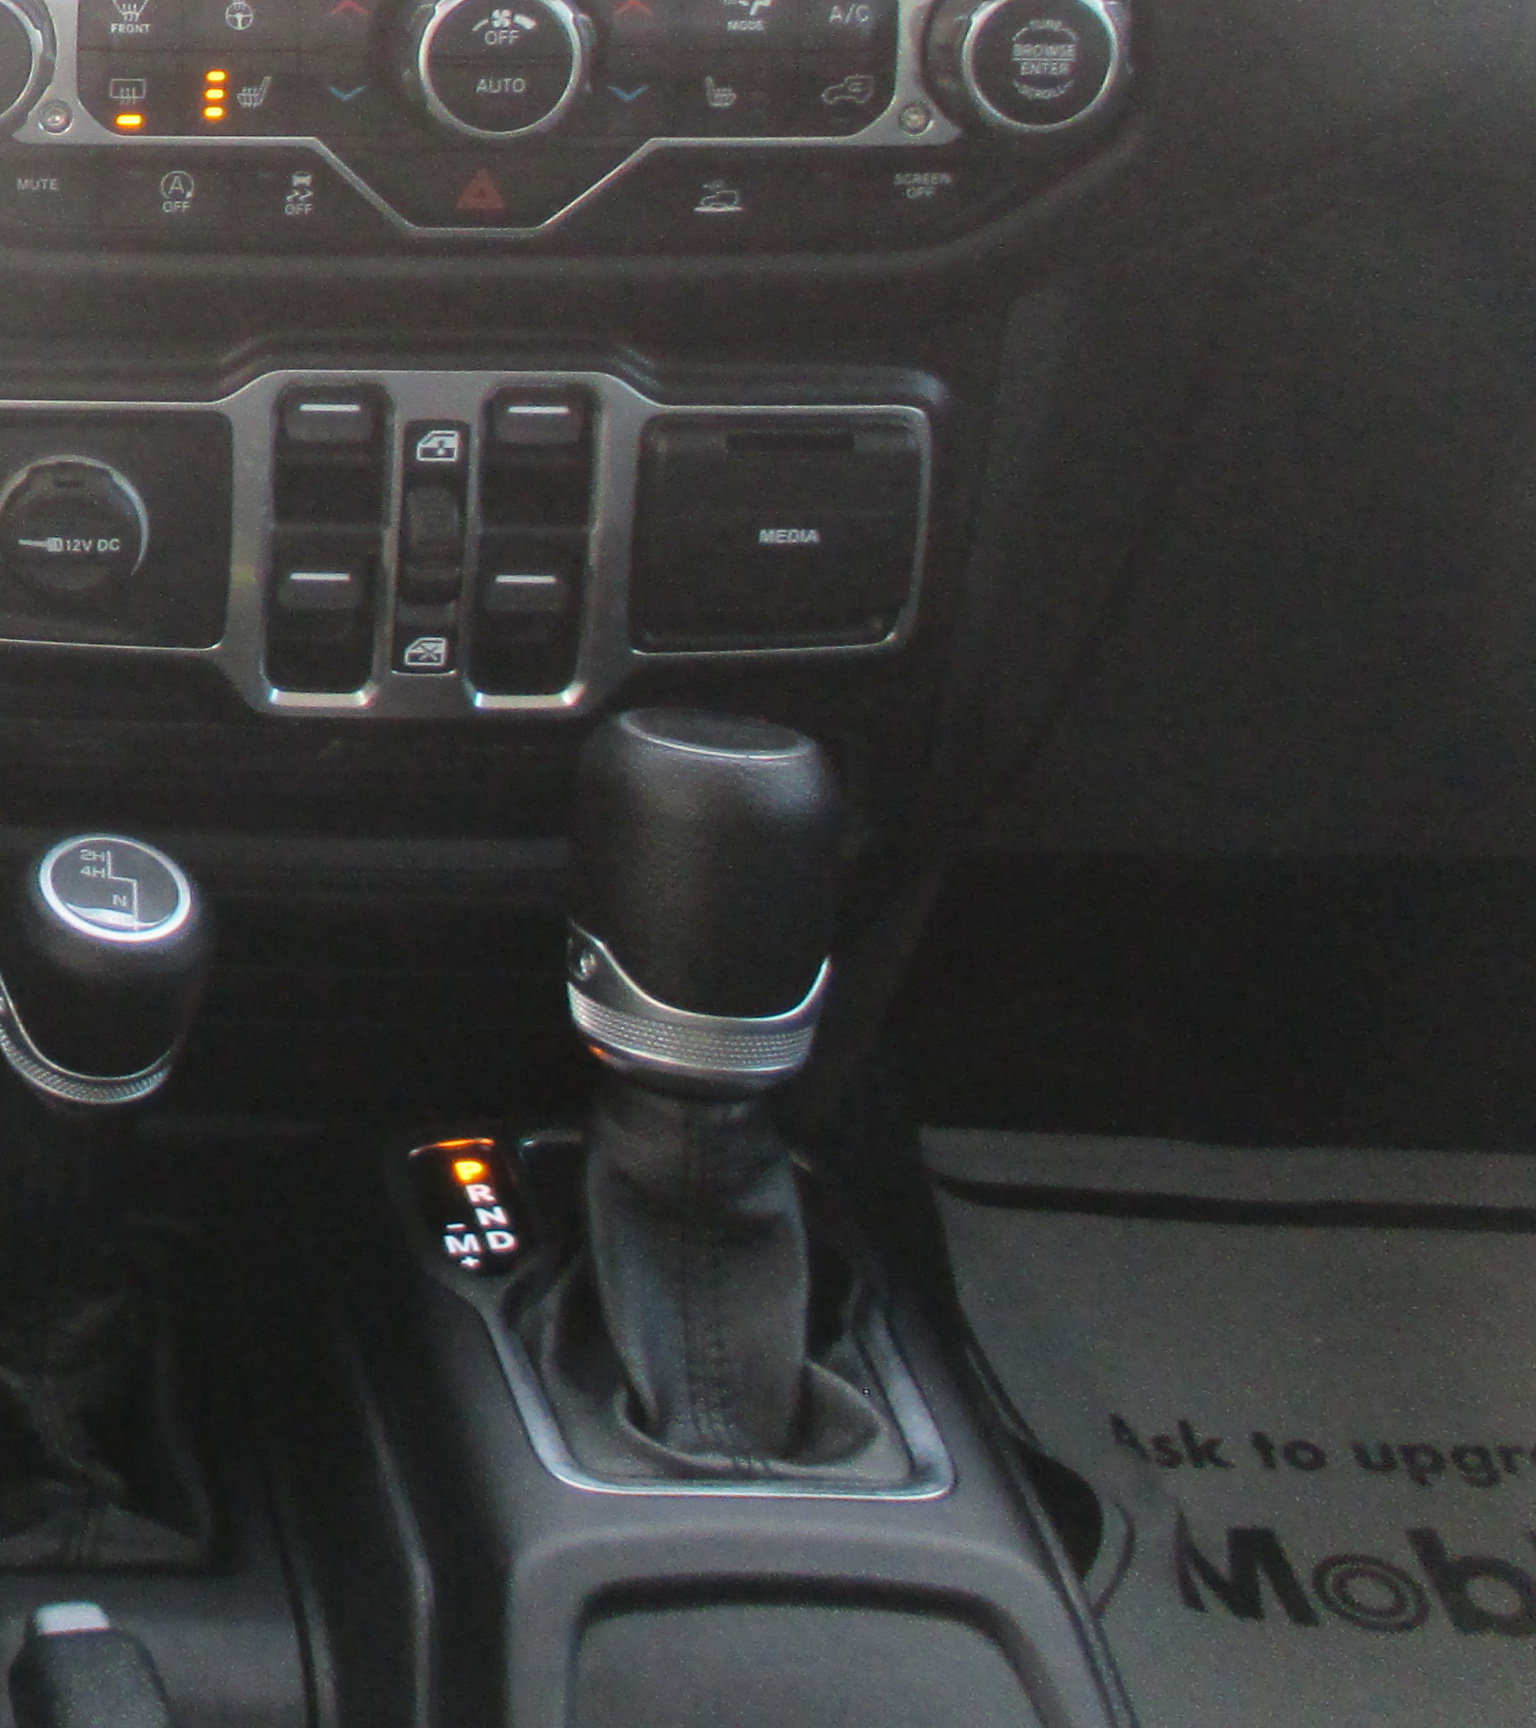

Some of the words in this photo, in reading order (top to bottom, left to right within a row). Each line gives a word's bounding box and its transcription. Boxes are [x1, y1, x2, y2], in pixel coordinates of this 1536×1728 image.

[830, 4, 871, 23] A/C
[110, 22, 150, 34] FRONT
[484, 30, 521, 45] OFF
[1021, 62, 1071, 75] ENTER
[475, 78, 526, 93] AUTO
[16, 177, 59, 191] MUTE
[162, 201, 191, 214] OFF
[284, 203, 313, 216] OFF
[759, 529, 819, 543] MEDIA
[66, 538, 92, 552] 12V
[97, 538, 120, 552] DC
[80, 848, 106, 861] 2H
[80, 865, 106, 878] 4H
[453, 1159, 485, 1182] P
[465, 1184, 496, 1204] R
[475, 1206, 510, 1227] N
[443, 1233, 482, 1256] M
[485, 1231, 518, 1253] D
[1250, 1431, 1327, 1471] to
